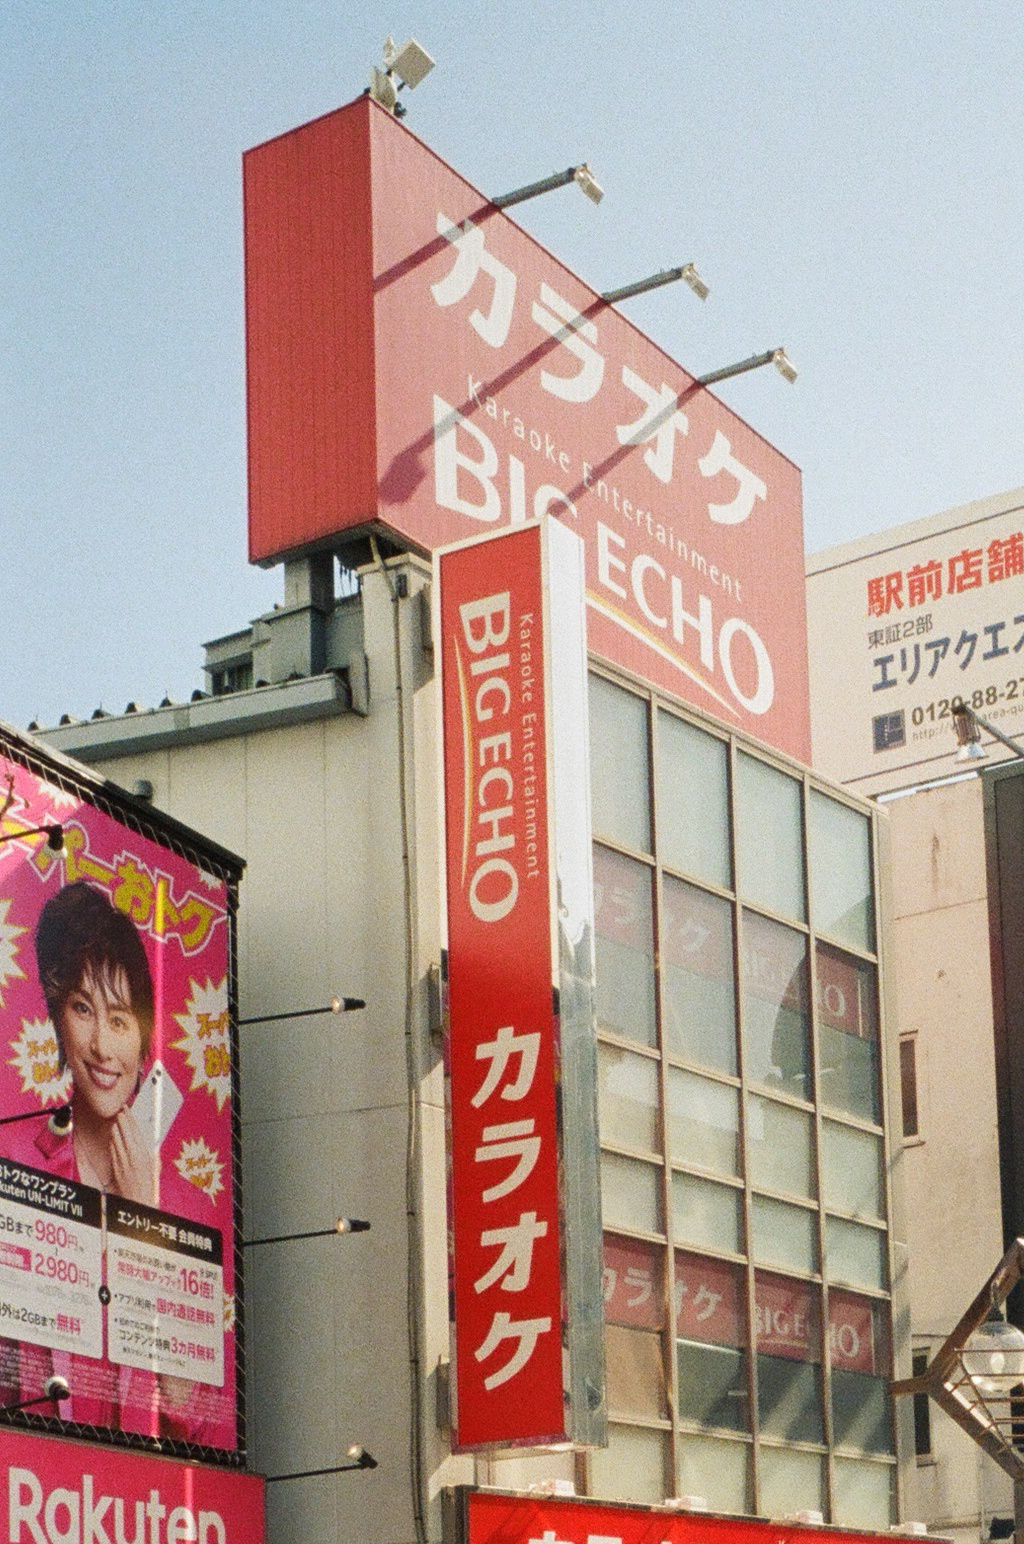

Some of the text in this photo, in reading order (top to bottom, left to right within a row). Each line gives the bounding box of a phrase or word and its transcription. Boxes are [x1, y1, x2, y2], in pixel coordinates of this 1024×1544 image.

[430, 211, 767, 526] カラオケ
[468, 374, 743, 602] Karaoke Entertainment
[597, 522, 774, 716] ECHO
[867, 612, 934, 650] 東証2部
[458, 591, 520, 923] BIG ECHO
[520, 613, 540, 880] Karaoke Entertainment
[27, 1189, 69, 1213] UN-LIMIT
[471, 1026, 552, 1391] カラオケ
